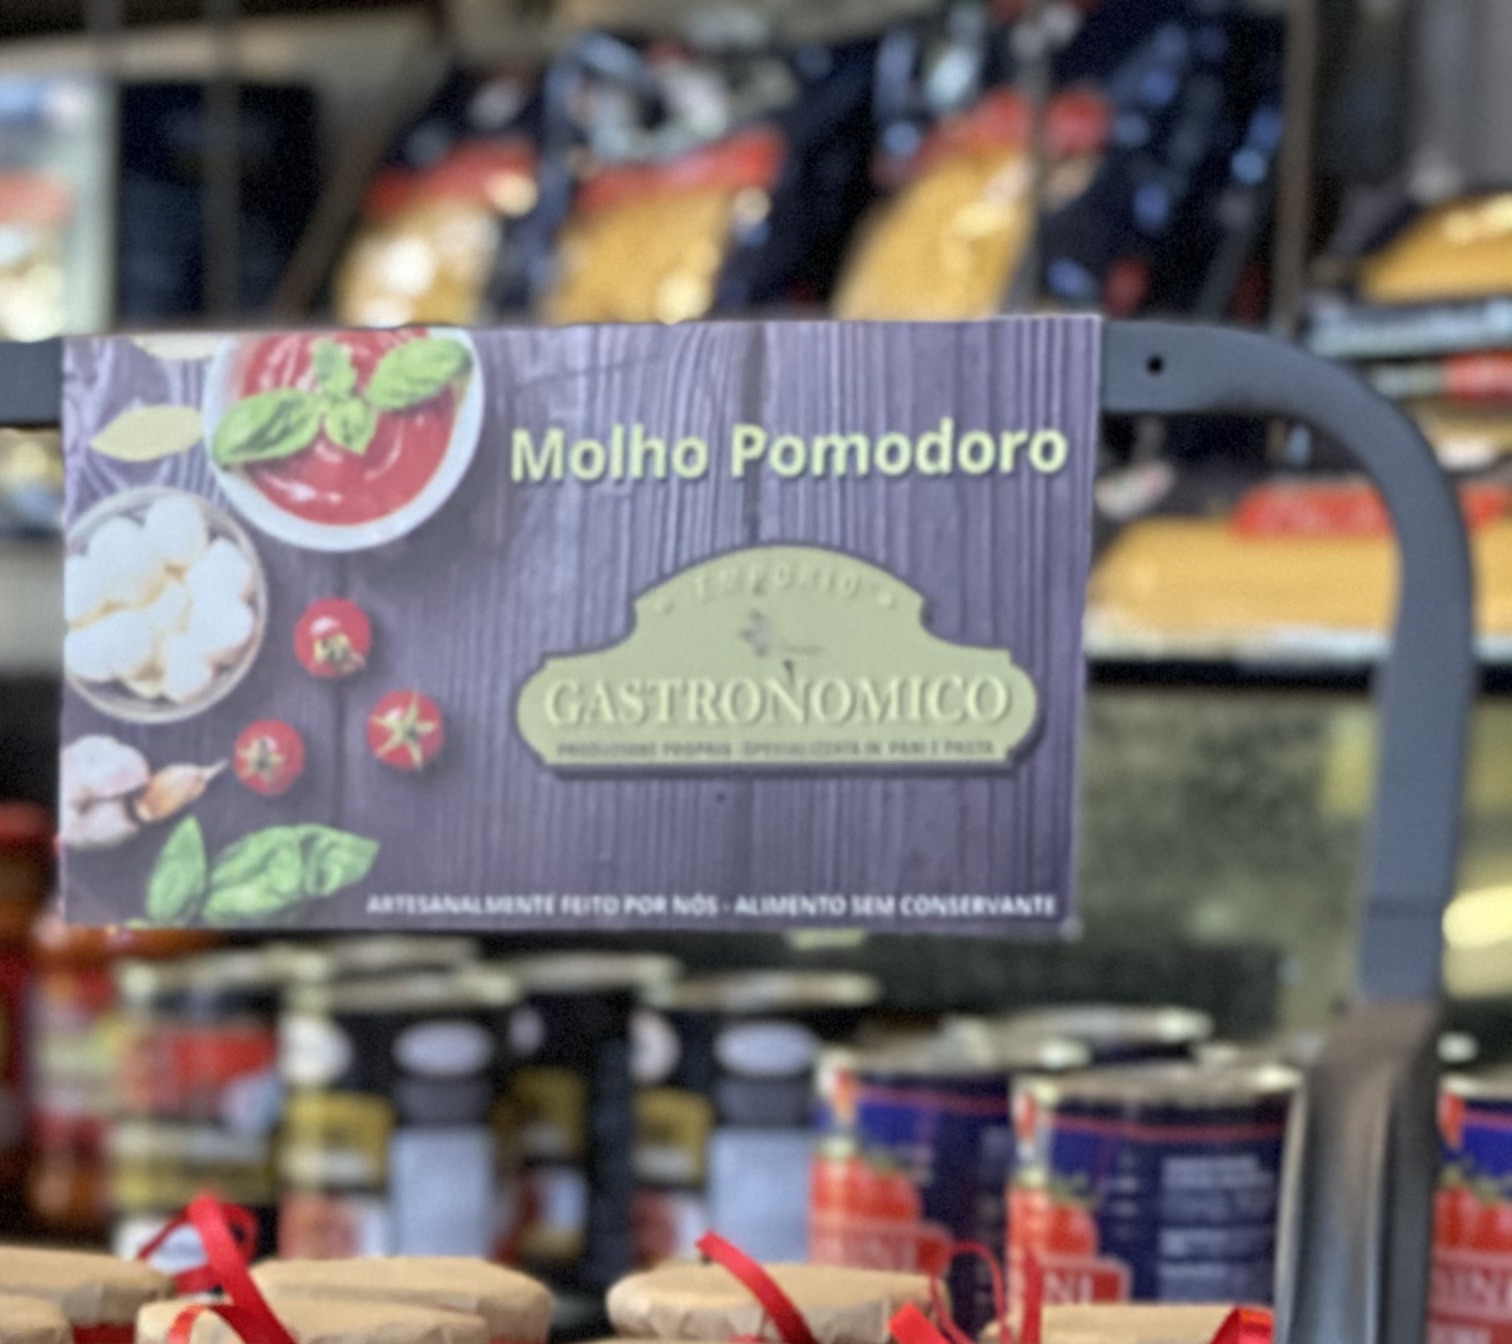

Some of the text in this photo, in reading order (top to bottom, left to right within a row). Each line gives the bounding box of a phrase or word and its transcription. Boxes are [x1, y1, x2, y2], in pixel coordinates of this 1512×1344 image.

[511, 417, 1068, 481] Molho Pomodoro
[543, 675, 1014, 727] GASTRONOMICO
[367, 895, 555, 916] ARTESANALMENTE
[560, 895, 620, 917] FEITO
[624, 895, 668, 917] POR
[672, 891, 719, 918] NÓS
[735, 895, 846, 917] ALIMENTO
[851, 895, 895, 917] SEM
[899, 894, 1057, 917] CONSERVANTE
